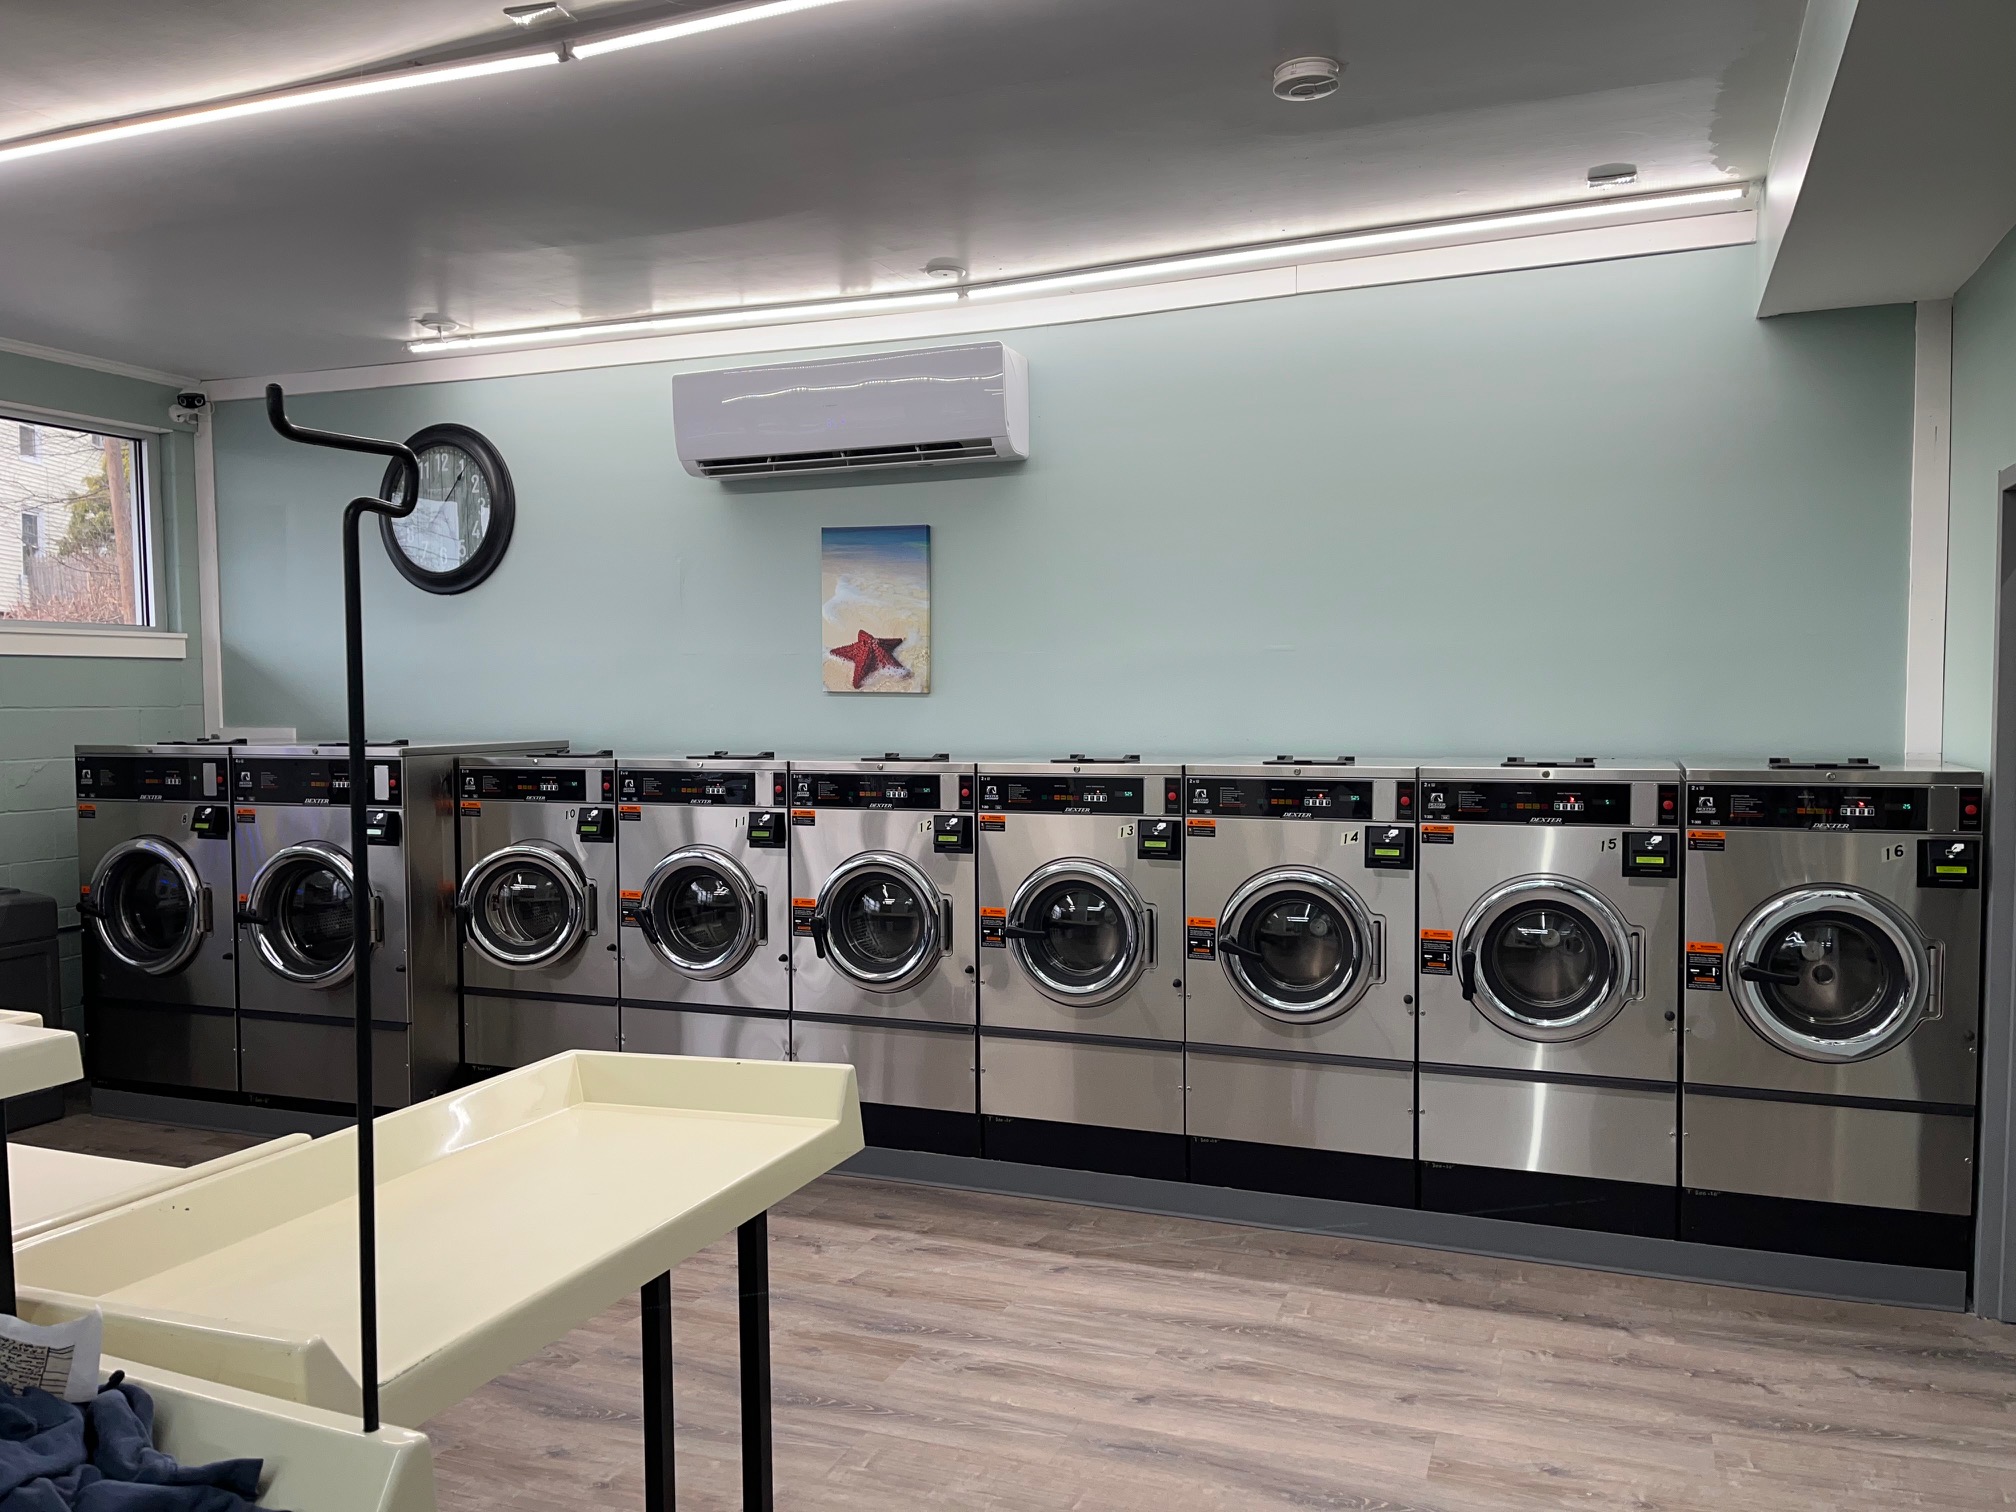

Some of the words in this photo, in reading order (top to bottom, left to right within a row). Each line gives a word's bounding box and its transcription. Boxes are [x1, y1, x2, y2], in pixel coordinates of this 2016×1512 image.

[435, 453, 448, 472] 12
[418, 461, 430, 480] 11
[471, 474, 480, 494] 2
[472, 520, 480, 538] 4
[440, 547, 448, 564] 6
[459, 540, 466, 558] 5
[566, 809, 575, 820] 10
[735, 816, 745, 828] 11
[920, 820, 932, 832] 12
[1120, 826, 1134, 838] 13
[1344, 831, 1358, 844] 14
[1601, 838, 1617, 852] 15
[1886, 845, 1904, 860] 16
